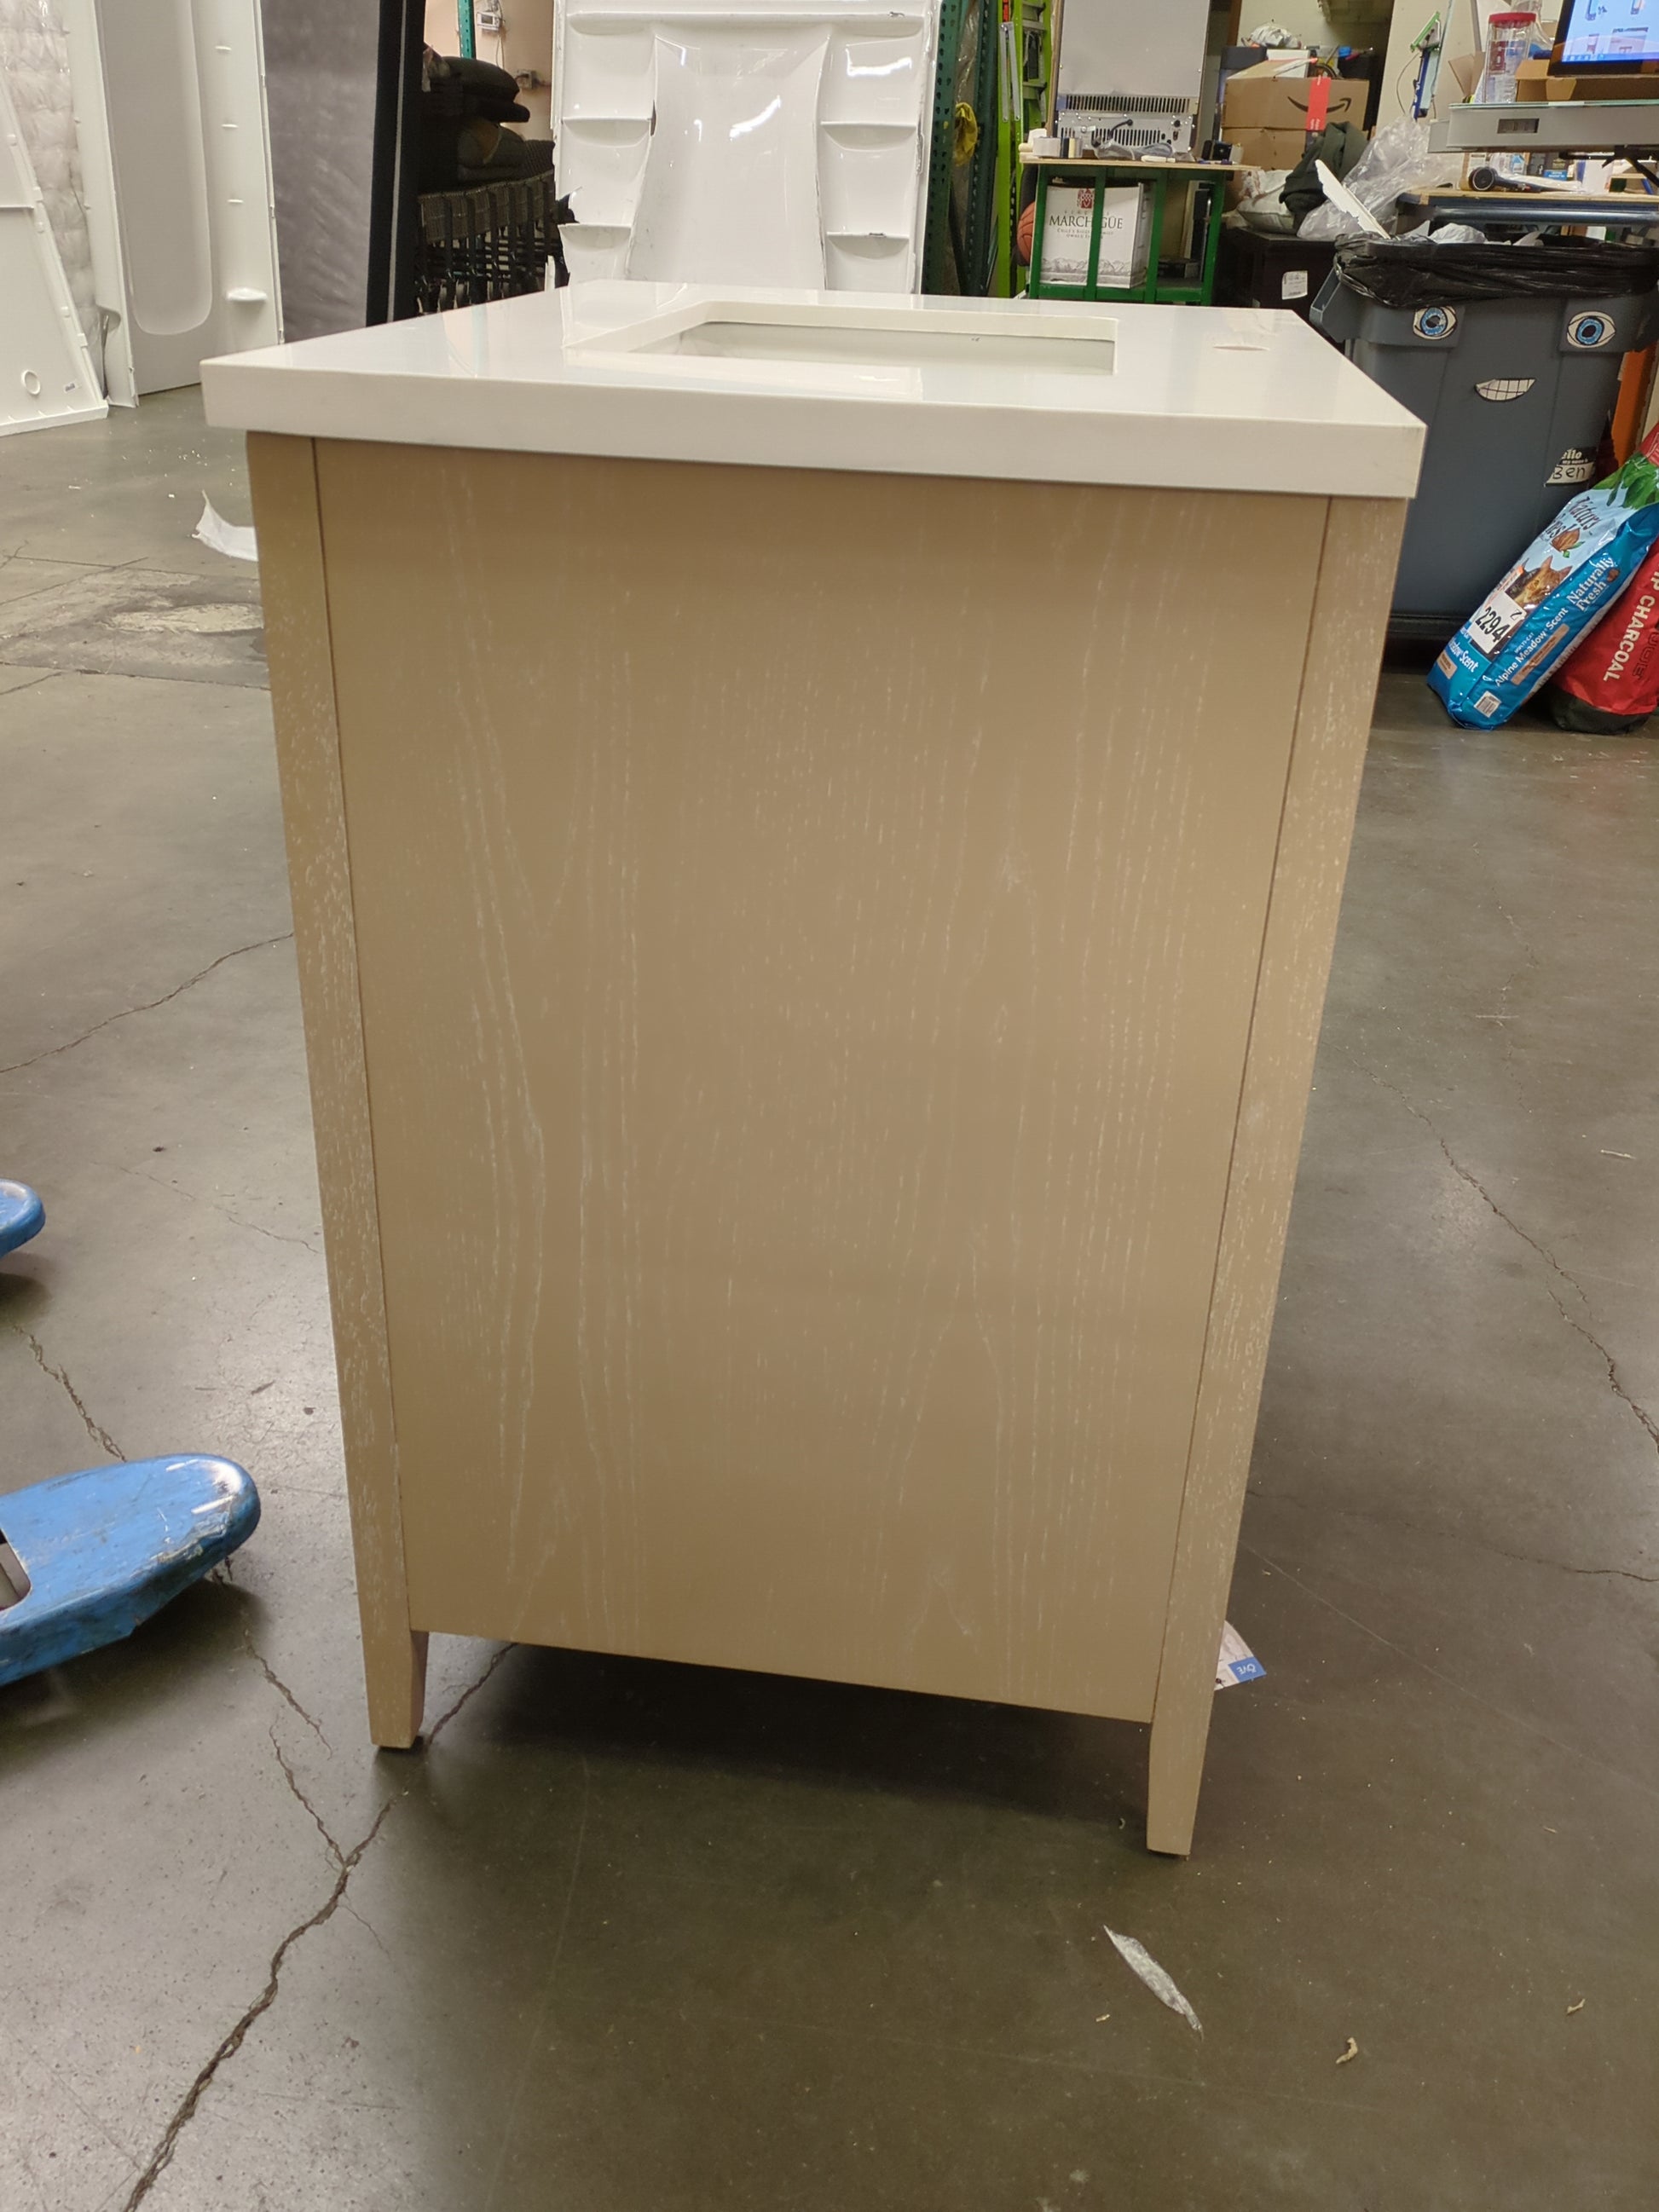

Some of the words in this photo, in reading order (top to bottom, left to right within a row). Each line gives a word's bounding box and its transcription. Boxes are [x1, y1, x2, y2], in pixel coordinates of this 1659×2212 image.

[1552, 465, 1586, 480] Ben
[1566, 556, 1615, 604] Naturally
[1575, 581, 1607, 611] Fresh
[1475, 606, 1511, 643] 2294
[1604, 595, 1656, 682] CHARCOAL
[1460, 650, 1479, 673] Scent
[1494, 661, 1519, 687] Alpine
[1515, 630, 1546, 663] Meadow
[1545, 607, 1569, 631] Scent
